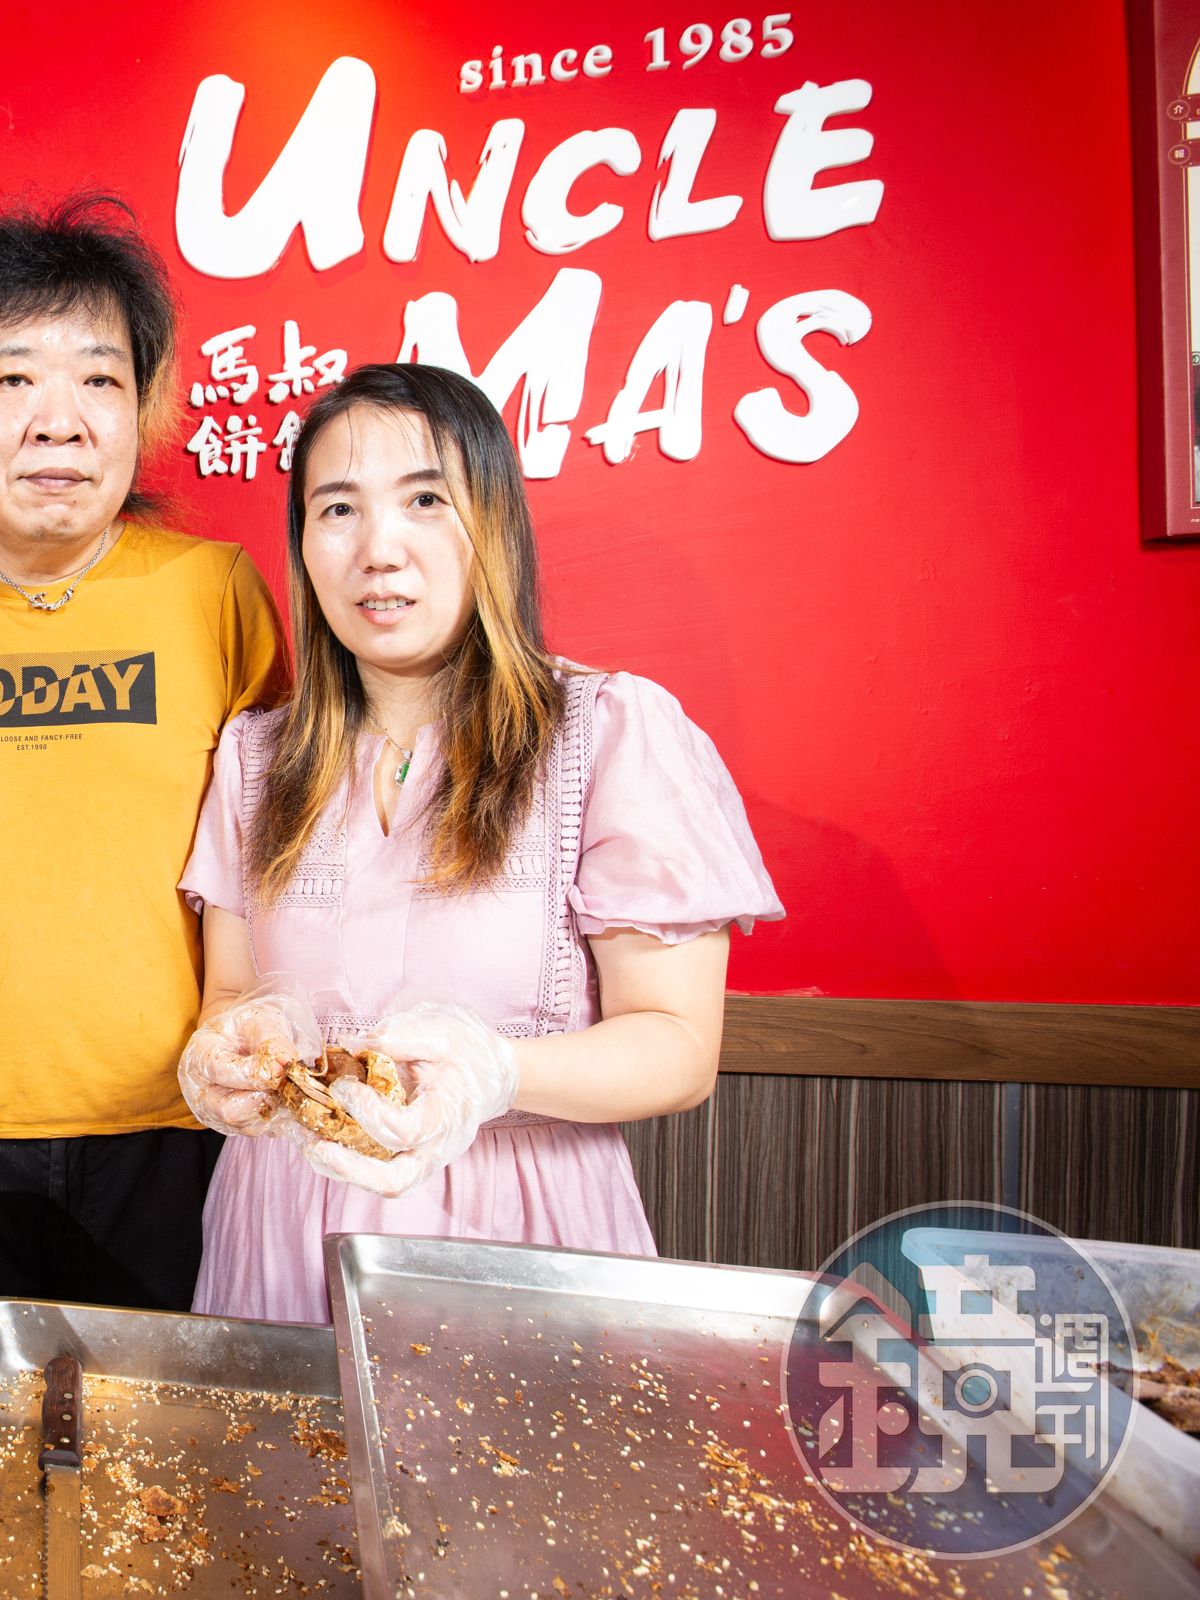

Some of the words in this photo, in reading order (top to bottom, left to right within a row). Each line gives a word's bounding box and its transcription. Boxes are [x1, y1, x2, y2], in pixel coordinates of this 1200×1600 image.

[460, 45, 613, 92] since
[644, 13, 795, 74] 1985
[175, 56, 885, 279] UNCLE
[191, 320, 348, 408] 馬叔
[399, 267, 872, 480] MA'S
[40, 733, 83, 741] FANCY-FREE
